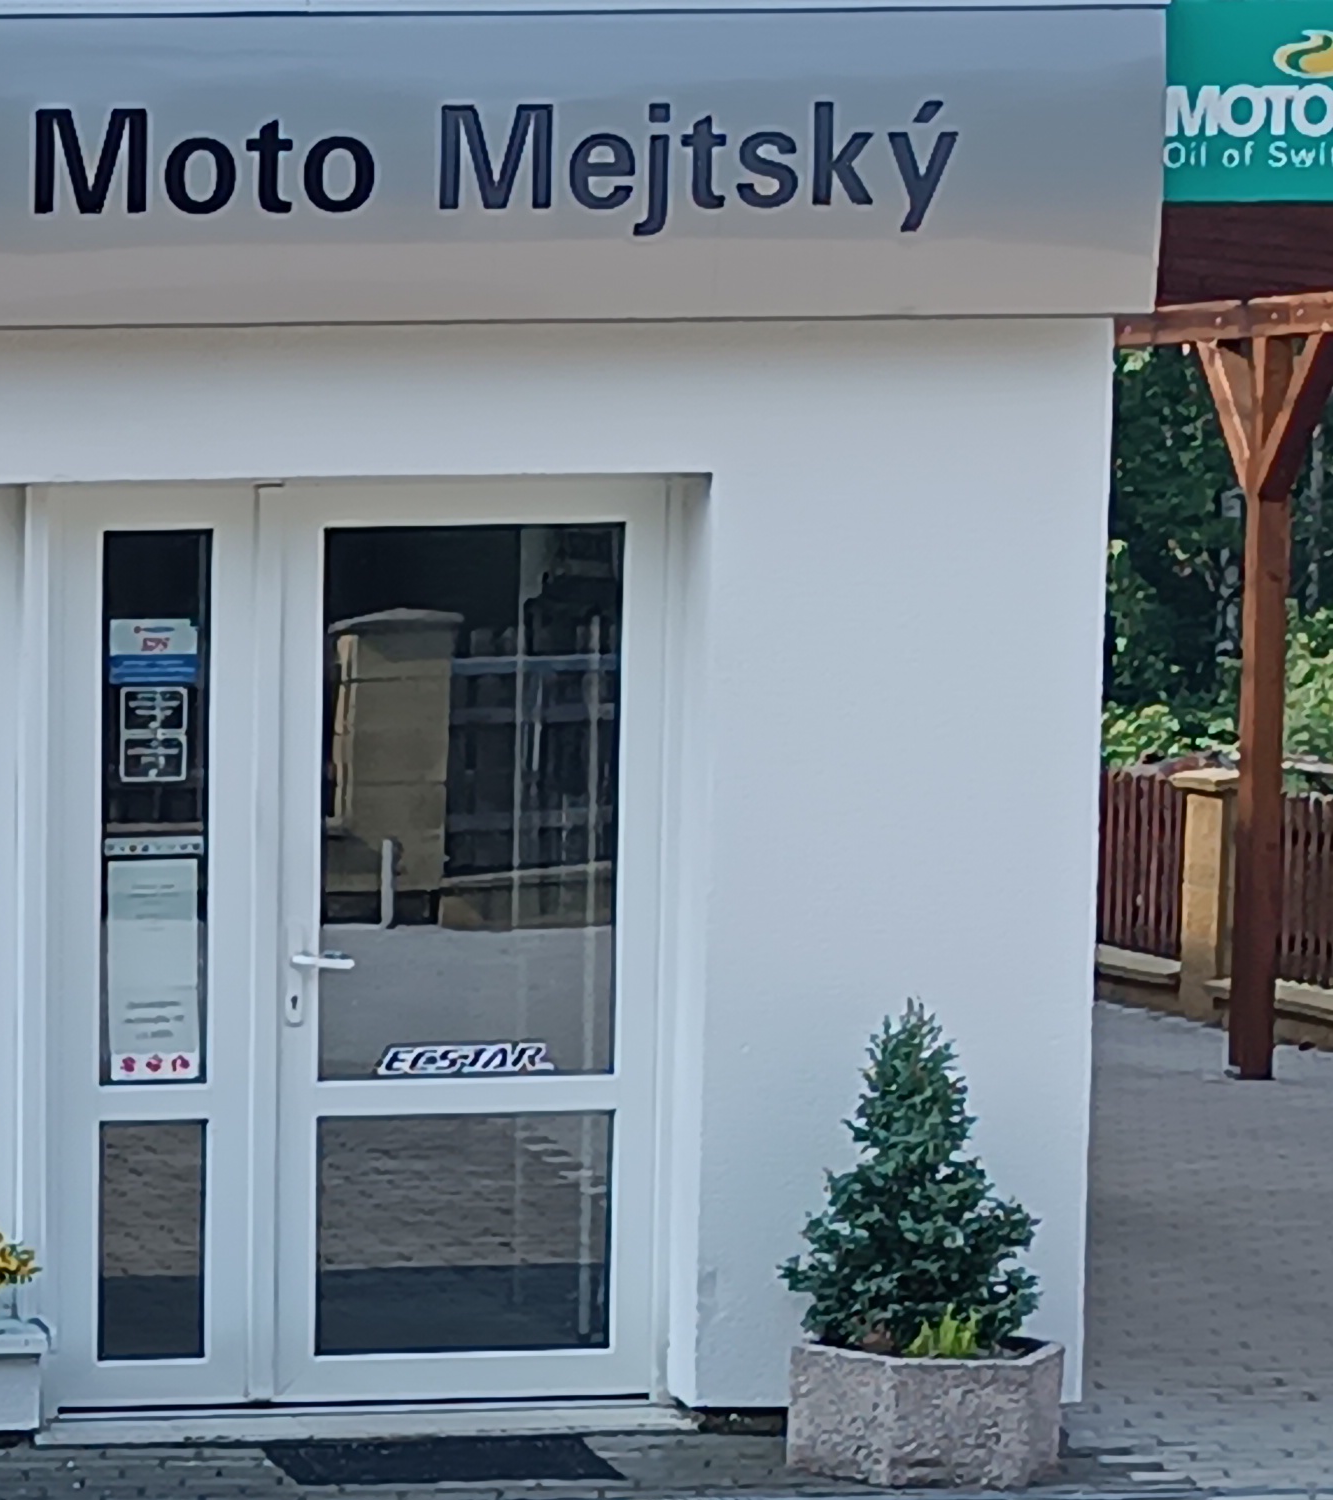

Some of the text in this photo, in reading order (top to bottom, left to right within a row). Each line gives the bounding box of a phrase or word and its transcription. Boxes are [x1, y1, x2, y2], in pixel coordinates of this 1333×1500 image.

[33, 100, 959, 236] Moto Mejtský
[1162, 140, 1333, 169] Oil of Swi
